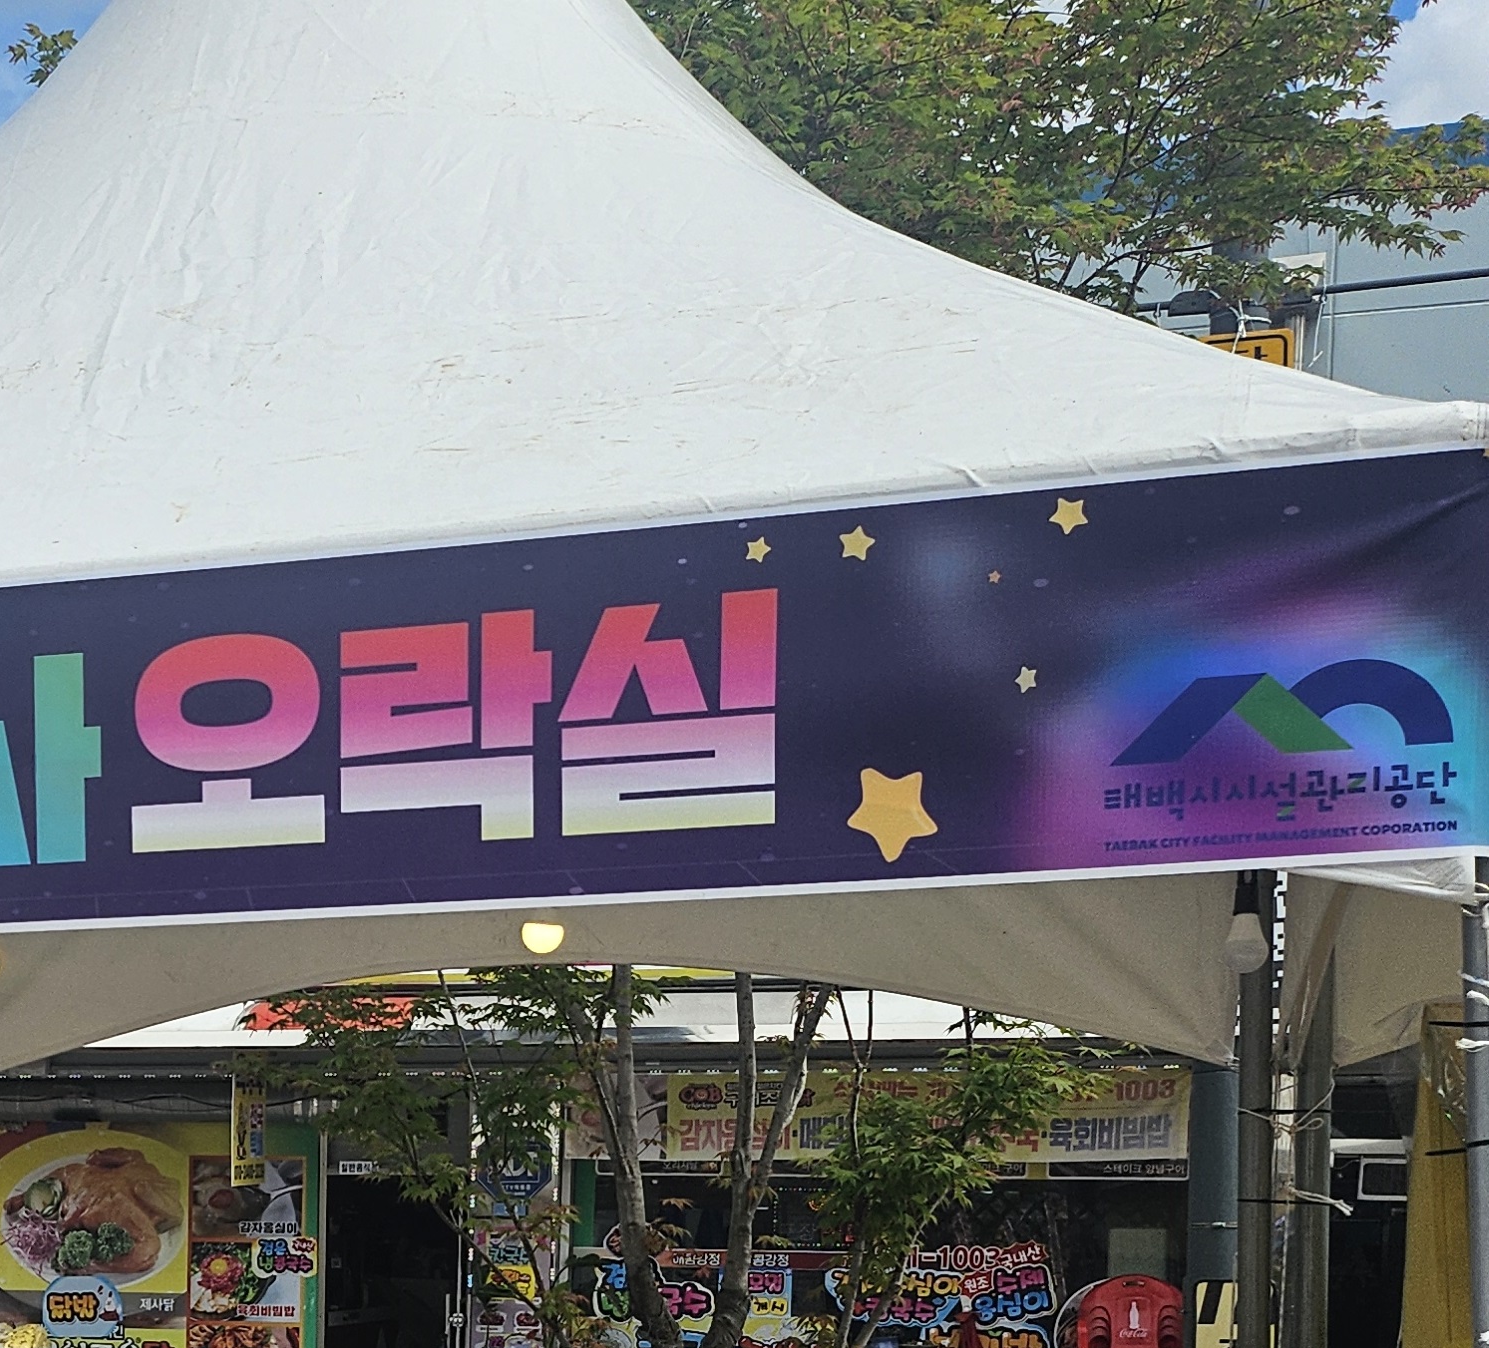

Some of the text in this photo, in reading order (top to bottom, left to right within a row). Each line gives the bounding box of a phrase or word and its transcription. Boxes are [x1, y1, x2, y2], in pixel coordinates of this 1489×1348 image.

[132, 588, 777, 853] 오락실
[1104, 762, 1457, 821] 태백시시설관리공단
[1361, 820, 1457, 836] COPORATION
